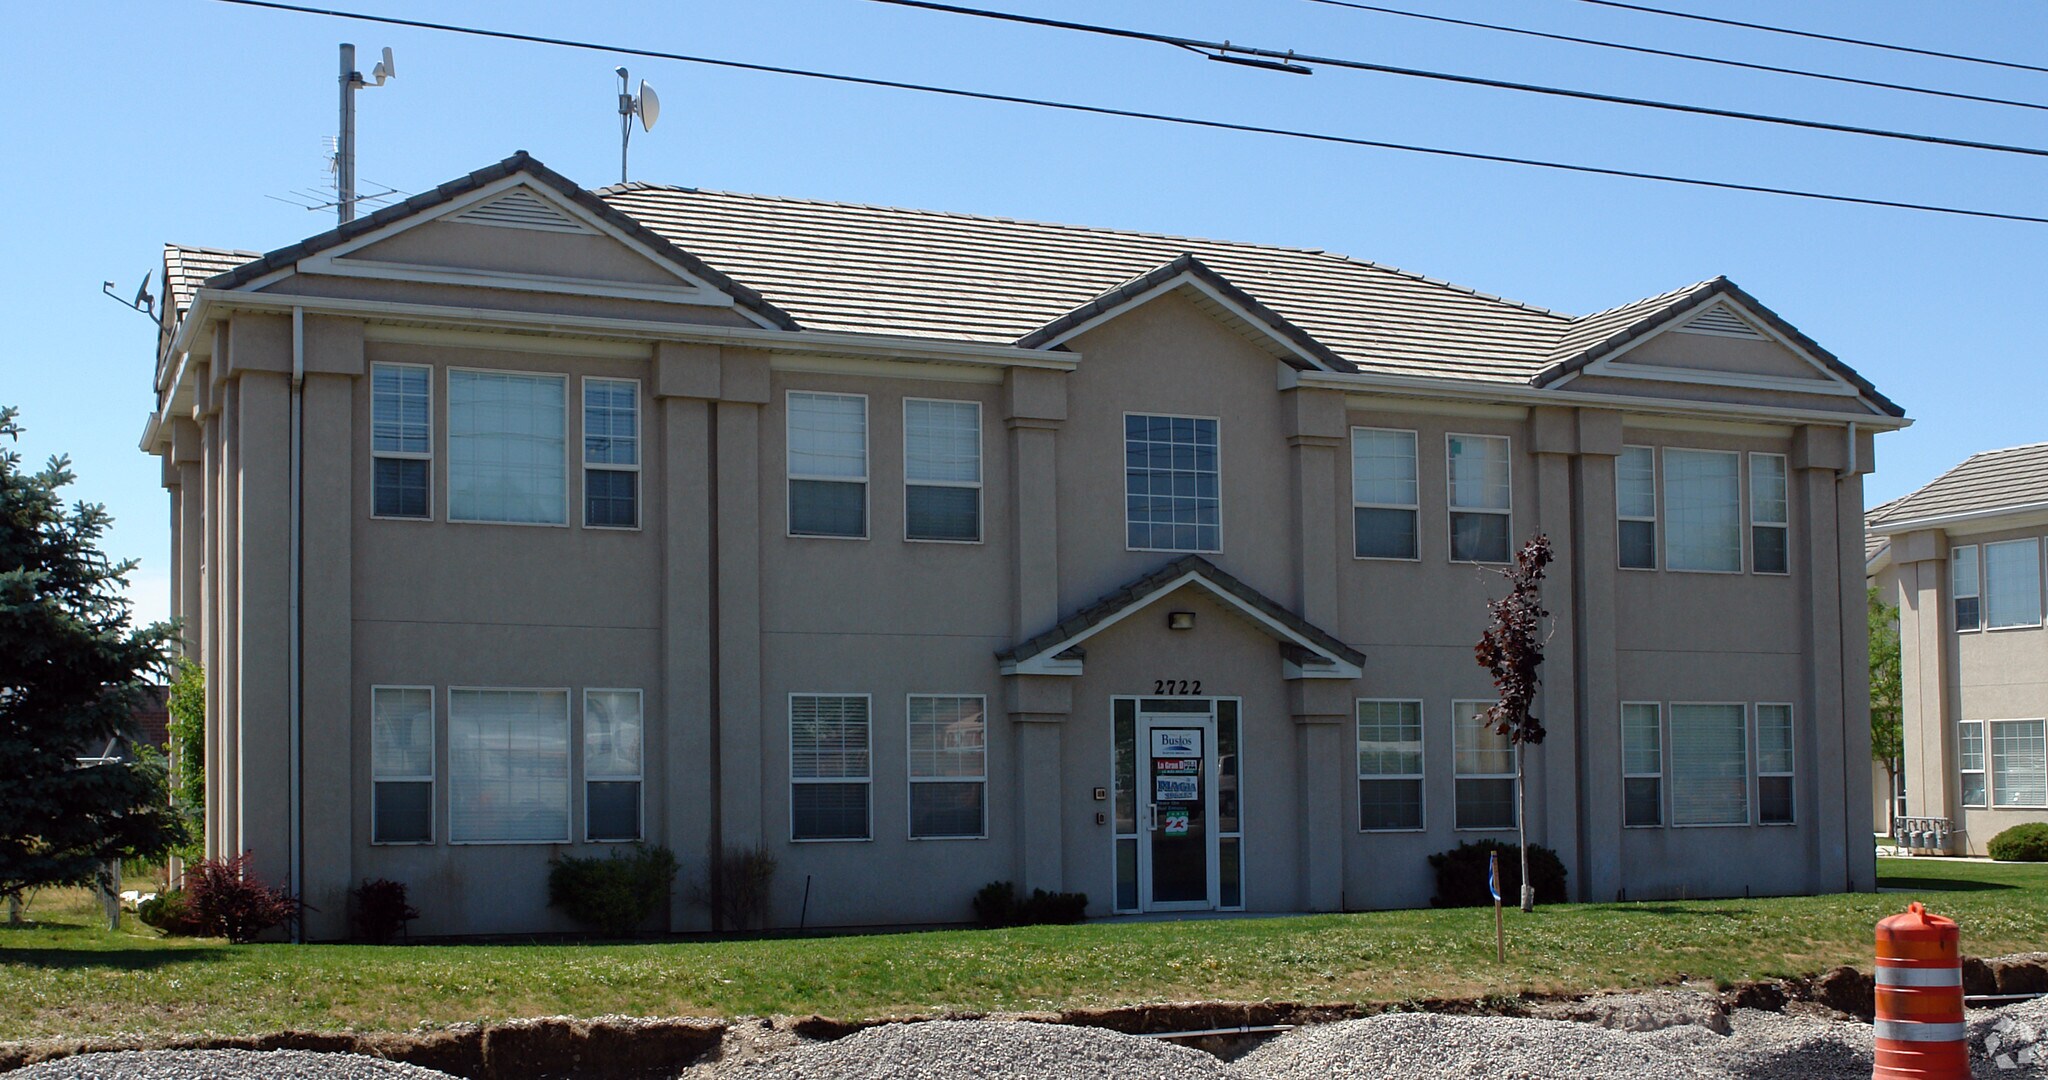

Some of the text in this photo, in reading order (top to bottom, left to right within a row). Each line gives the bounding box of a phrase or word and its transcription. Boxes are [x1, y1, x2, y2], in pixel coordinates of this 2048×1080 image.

[1155, 680, 1202, 695] 2722
[1162, 734, 1192, 745] Bustos
[1157, 761, 1164, 769] La
[1165, 761, 1178, 769] Gran
[1165, 816, 1189, 832] 23
